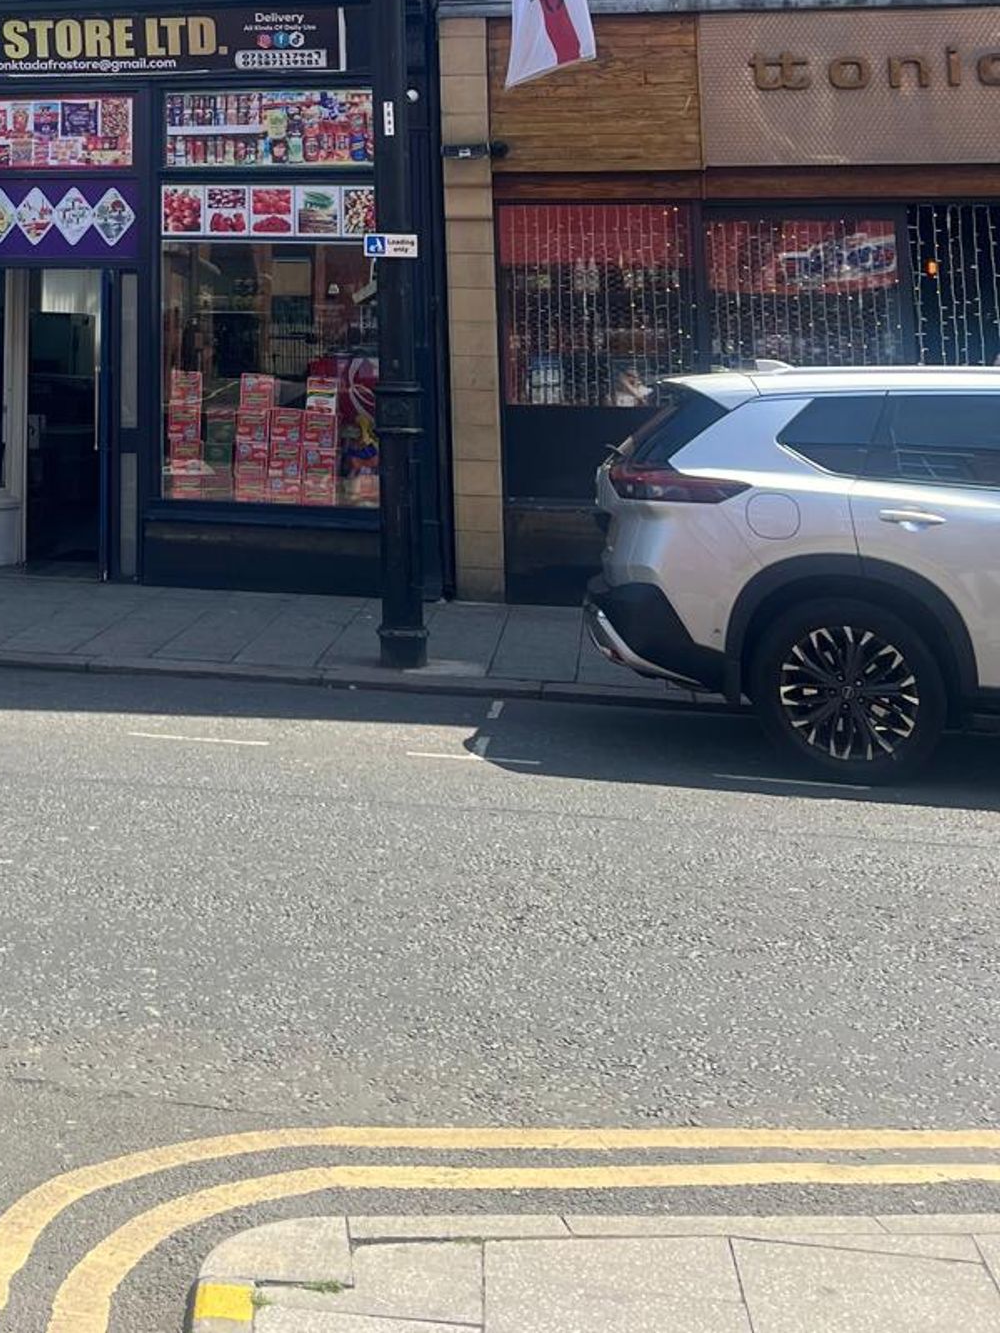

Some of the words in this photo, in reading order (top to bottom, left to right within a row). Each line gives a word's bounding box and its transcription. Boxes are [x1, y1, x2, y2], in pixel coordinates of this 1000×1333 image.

[254, 12, 305, 24] Delivery
[2, 17, 135, 60] STORE
[145, 16, 229, 58] LTD.
[387, 238, 415, 247] Loading
